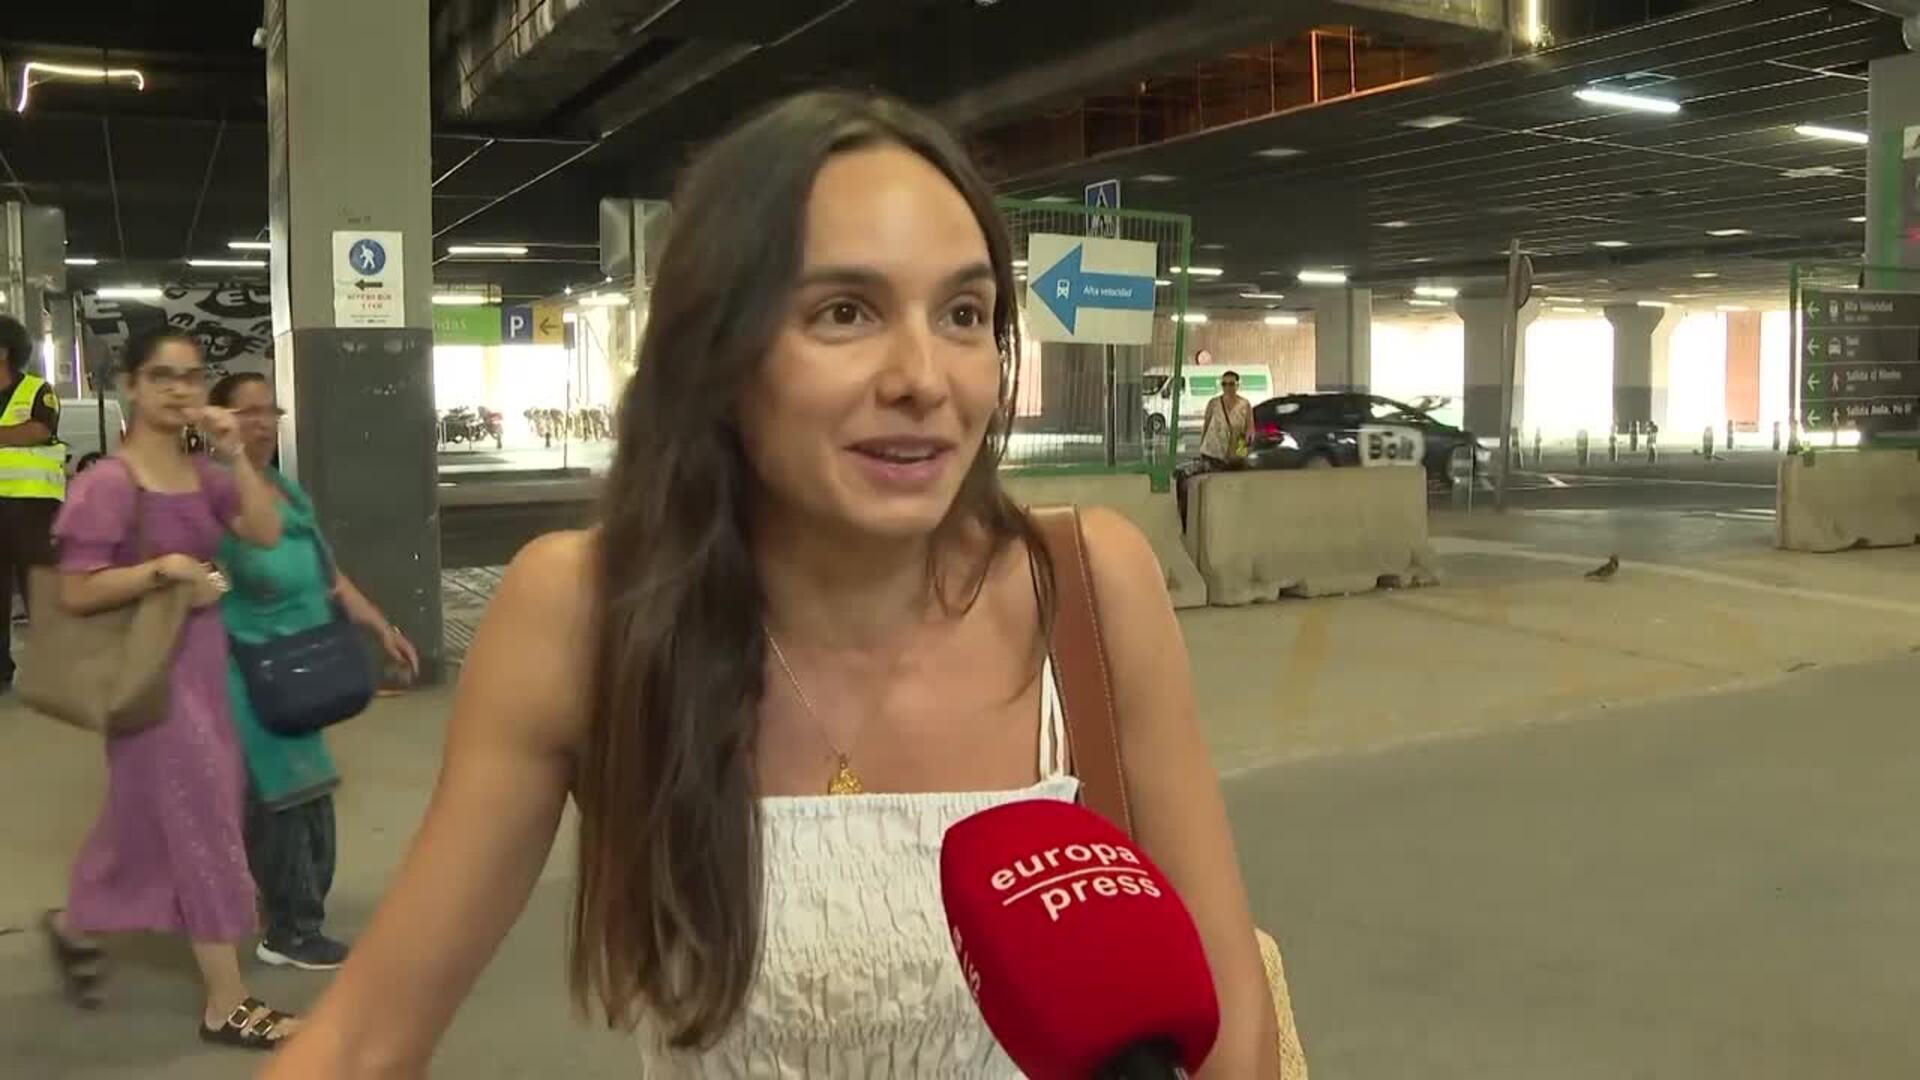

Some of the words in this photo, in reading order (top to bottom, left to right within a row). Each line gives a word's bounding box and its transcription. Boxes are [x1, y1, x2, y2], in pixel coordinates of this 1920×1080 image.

[1083, 284, 1099, 296] Alta
[510, 315, 525, 338] P
[991, 843, 1140, 890] europa
[1040, 875, 1161, 922] press
